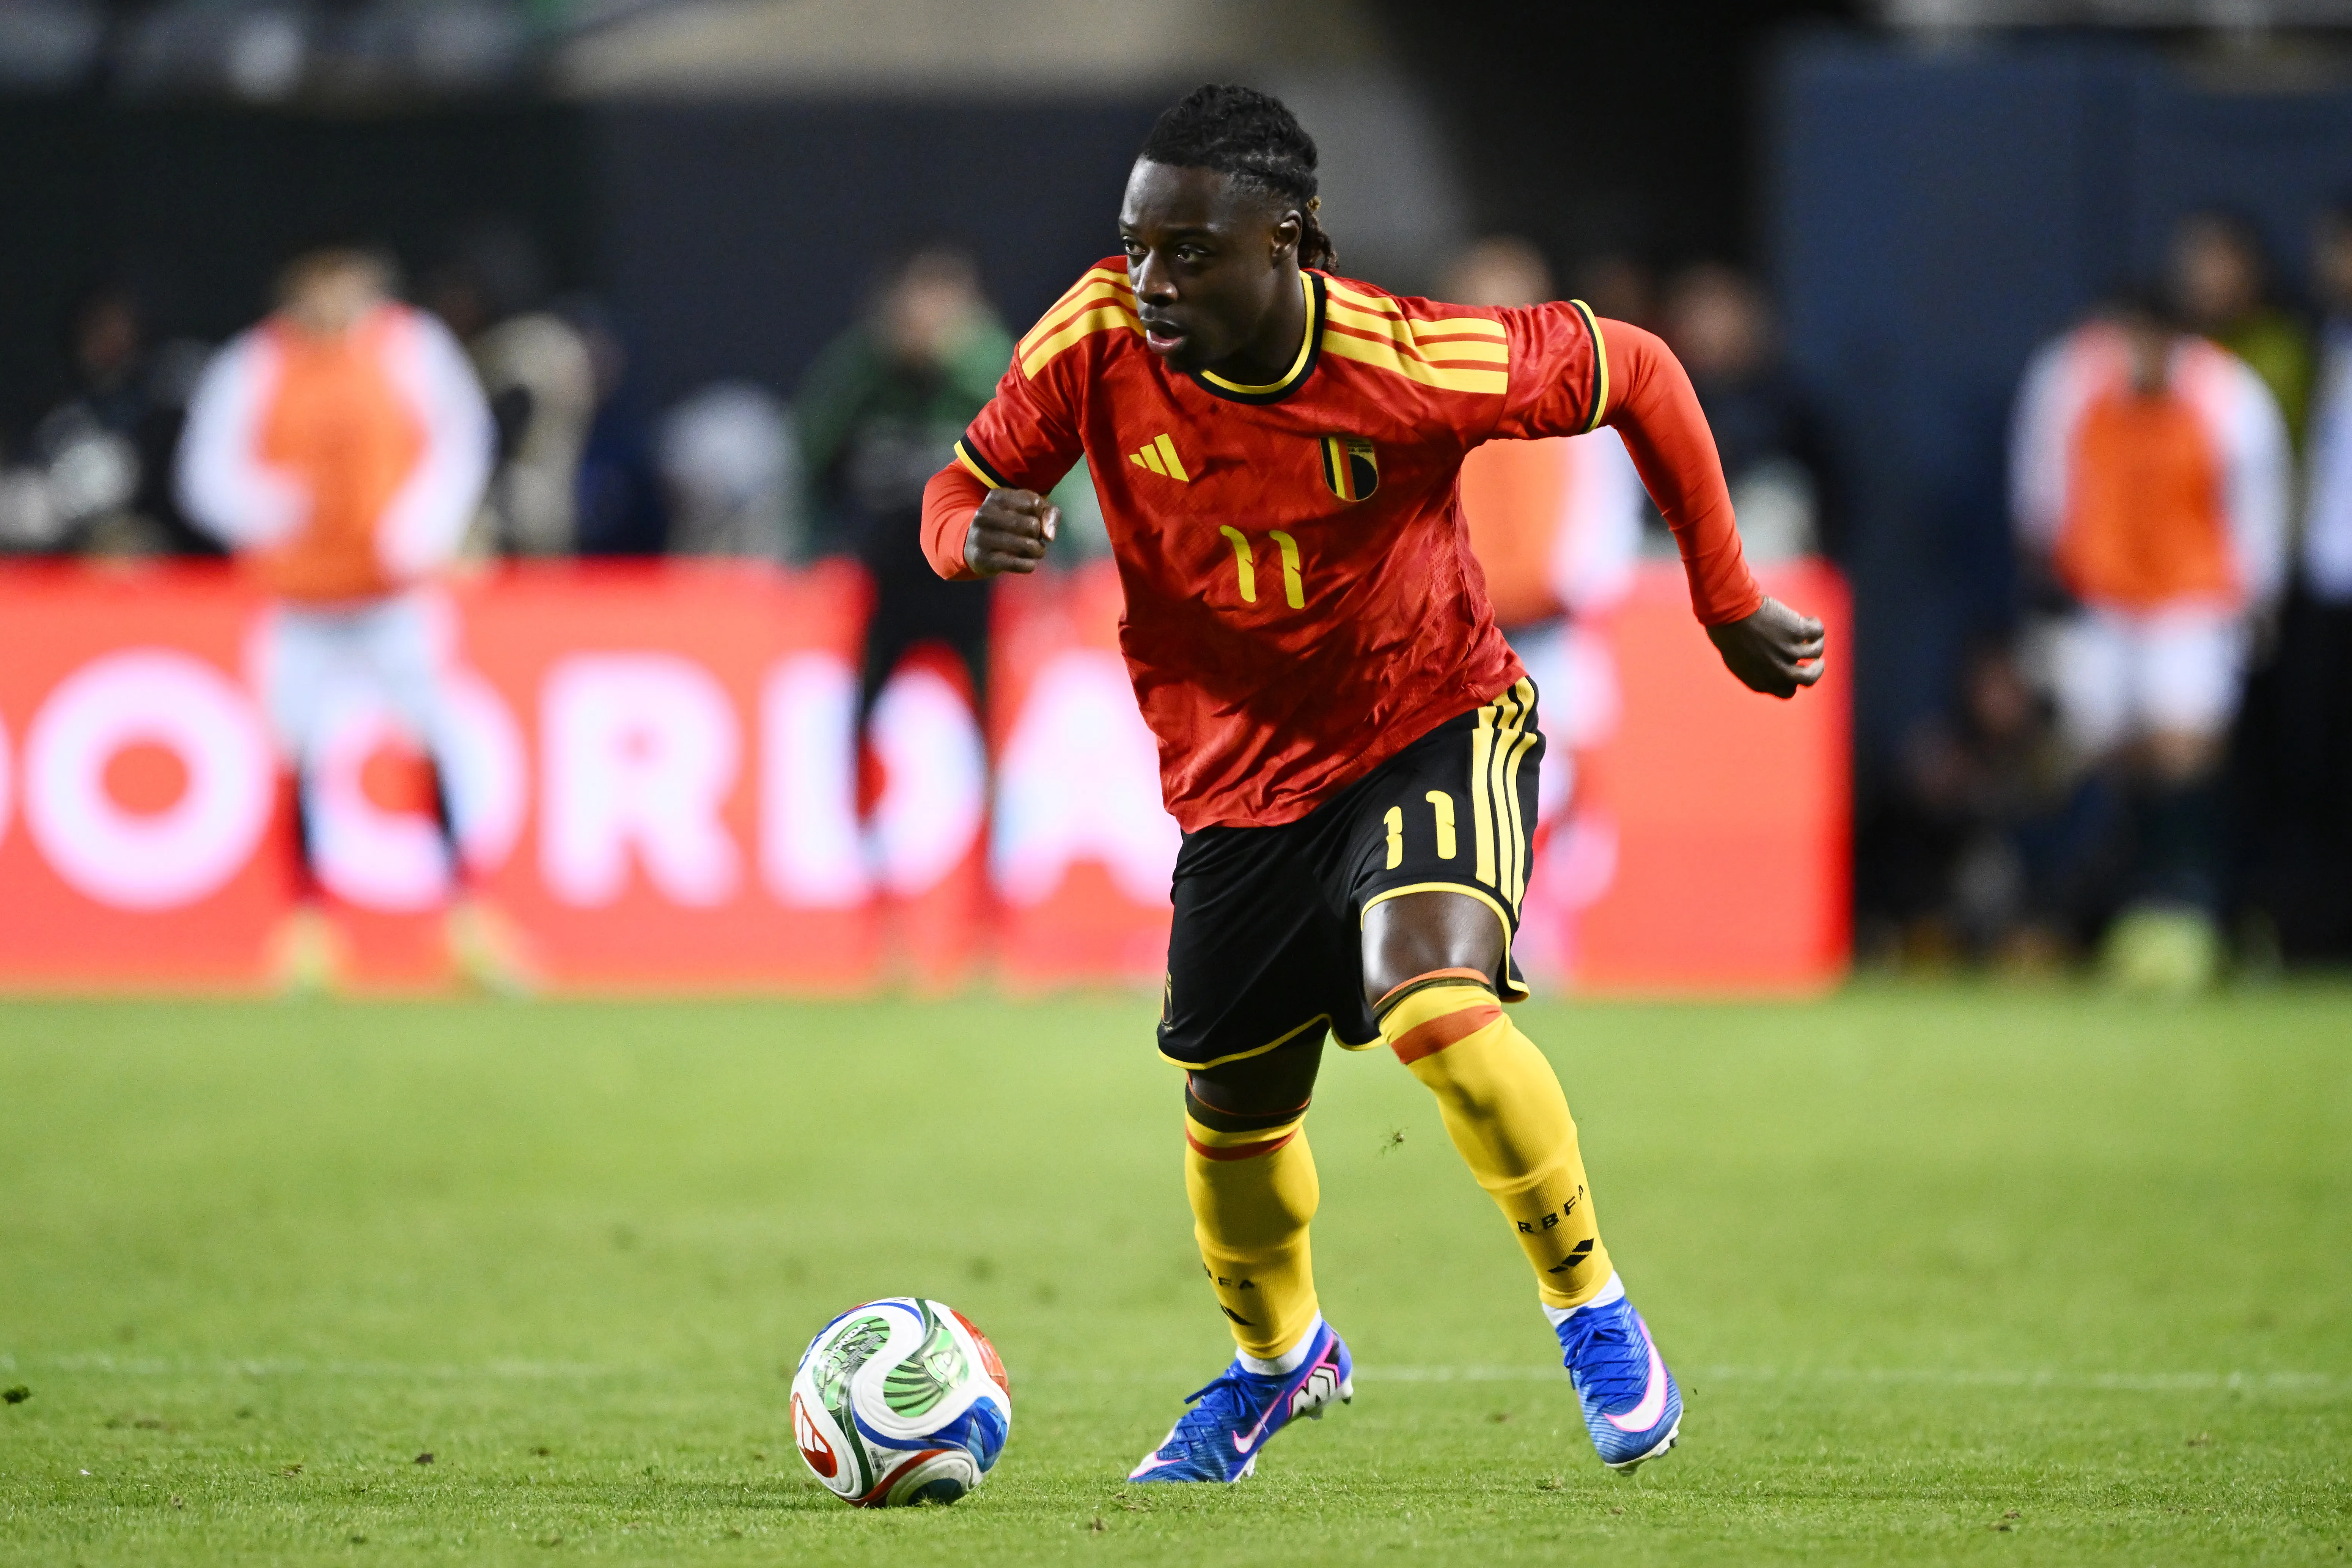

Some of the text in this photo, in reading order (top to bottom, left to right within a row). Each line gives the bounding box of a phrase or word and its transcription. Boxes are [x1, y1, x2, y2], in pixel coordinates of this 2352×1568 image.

[1220, 525, 1305, 609] 11
[0, 649, 1181, 910] OORDA
[1384, 790, 1457, 870] 11
